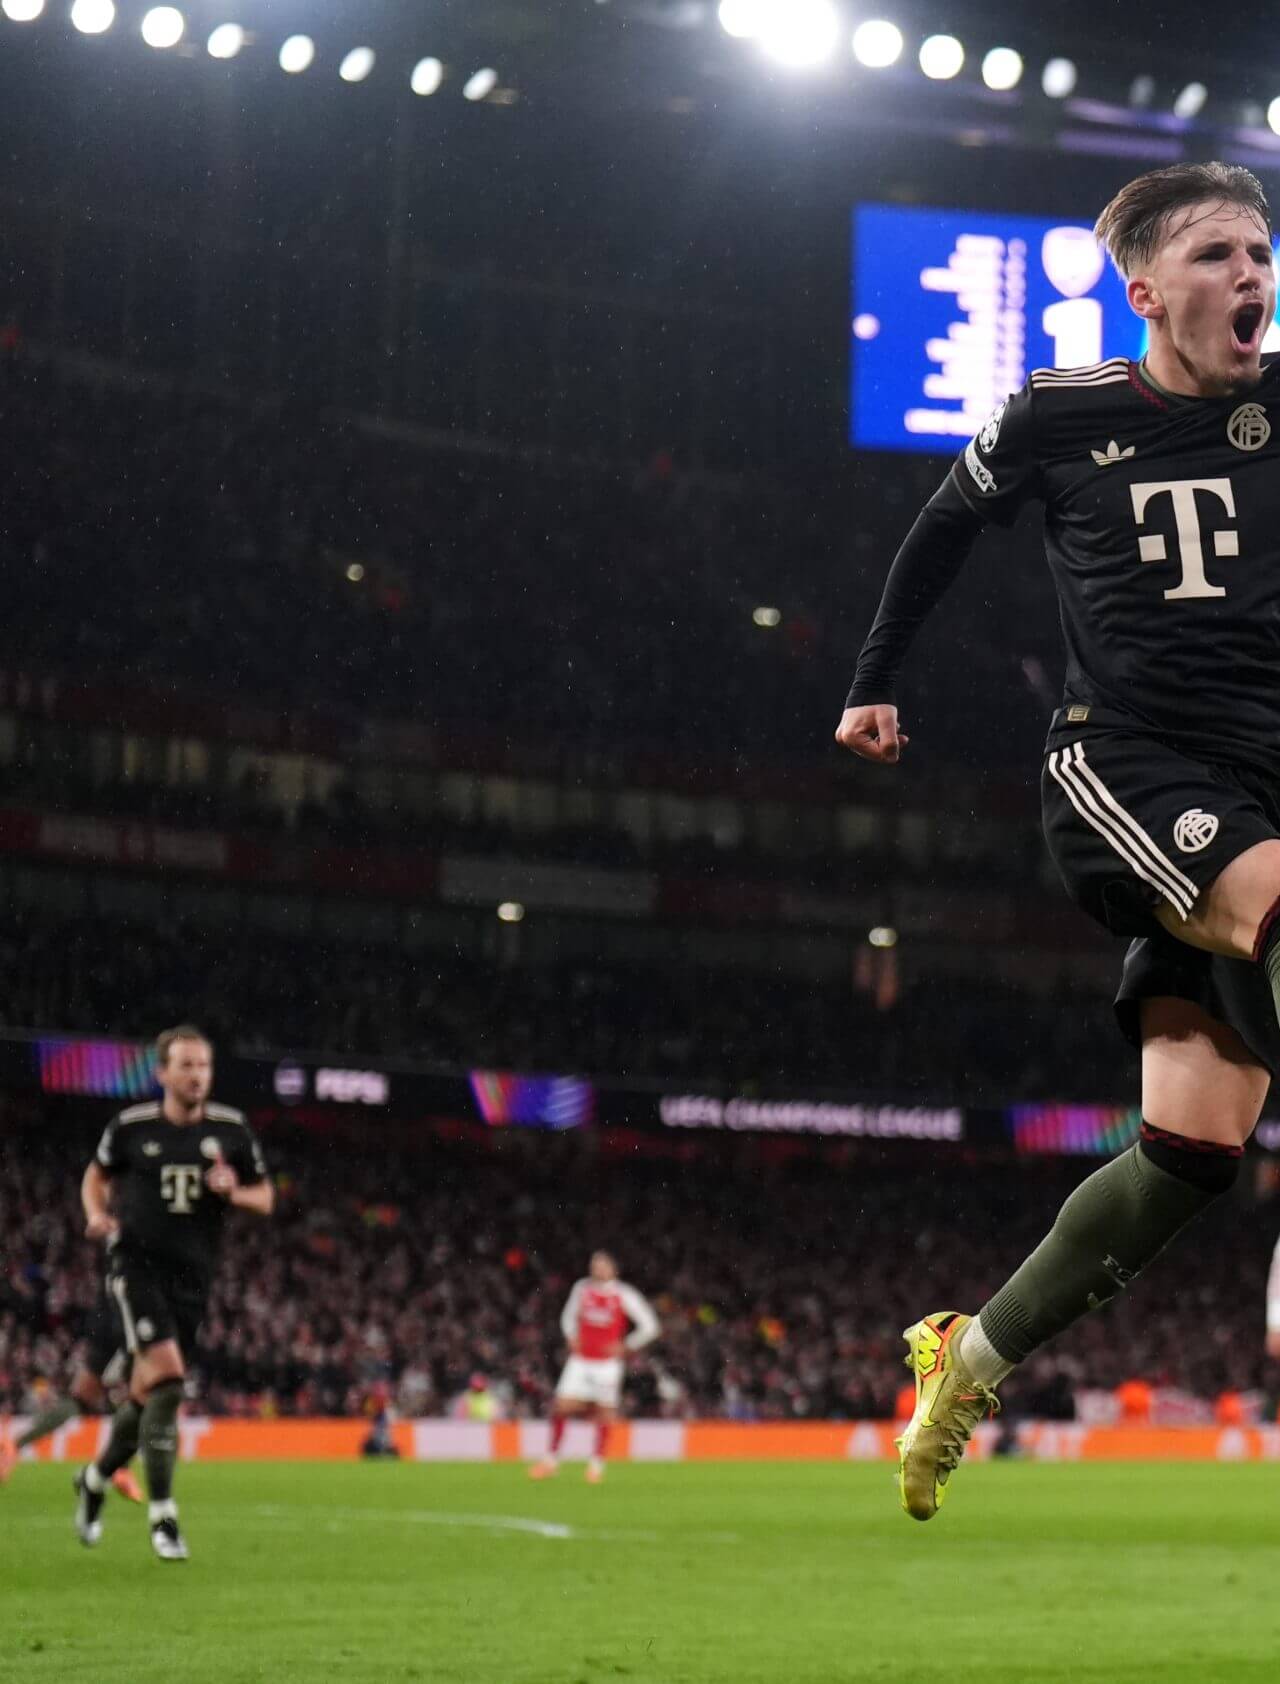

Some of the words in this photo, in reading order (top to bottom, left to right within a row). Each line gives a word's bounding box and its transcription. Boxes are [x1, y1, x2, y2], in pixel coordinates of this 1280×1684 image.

[1042, 297, 1103, 370] 1
[1129, 477, 1240, 601] T
[725, 1098, 865, 1137] CHAMPIONS
[161, 1164, 201, 1214] T
